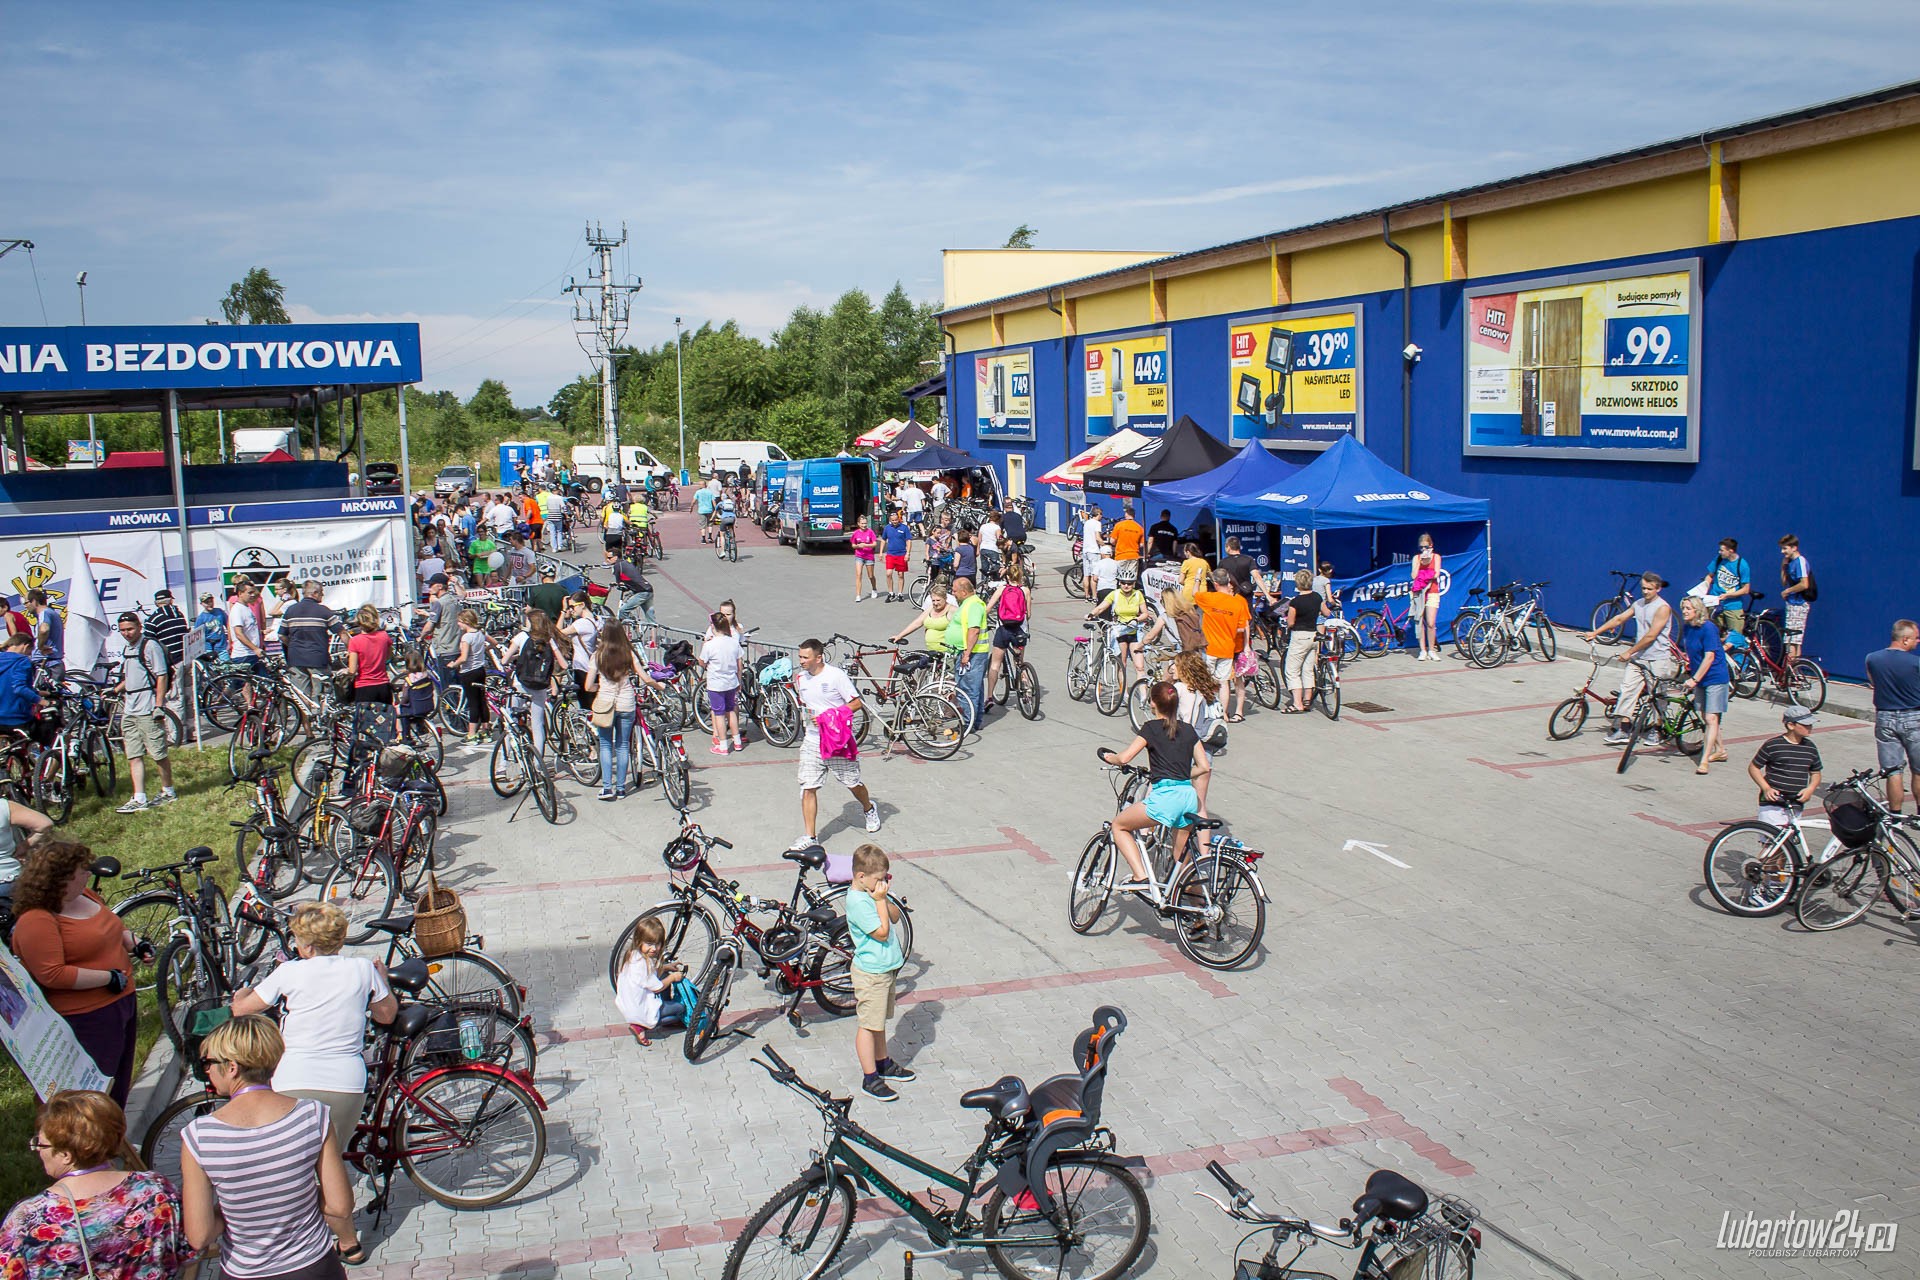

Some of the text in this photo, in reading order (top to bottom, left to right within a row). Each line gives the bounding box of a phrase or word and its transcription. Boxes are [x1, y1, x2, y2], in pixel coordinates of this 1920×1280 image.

[1486, 308, 1506, 327] HIT!
[1479, 325, 1510, 344] cenowy
[1236, 335, 1250, 350] HIT
[86, 340, 402, 372] BEZDOTYKOWA
[1296, 354, 1307, 367] od
[1611, 353, 1624, 366] od
[1631, 381, 1679, 392] SKRZYDŁO
[1340, 389, 1351, 399] LED
[1595, 397, 1678, 408] DRZWIOWE HELIOS
[1590, 426, 1679, 442] www.mrowka.com.pl
[1353, 493, 1409, 503] Allianz
[341, 499, 398, 513] MRÓWKA
[109, 512, 172, 526] MRÓWKA
[1225, 524, 1255, 533] Allianz
[1281, 535, 1303, 545] Allianz
